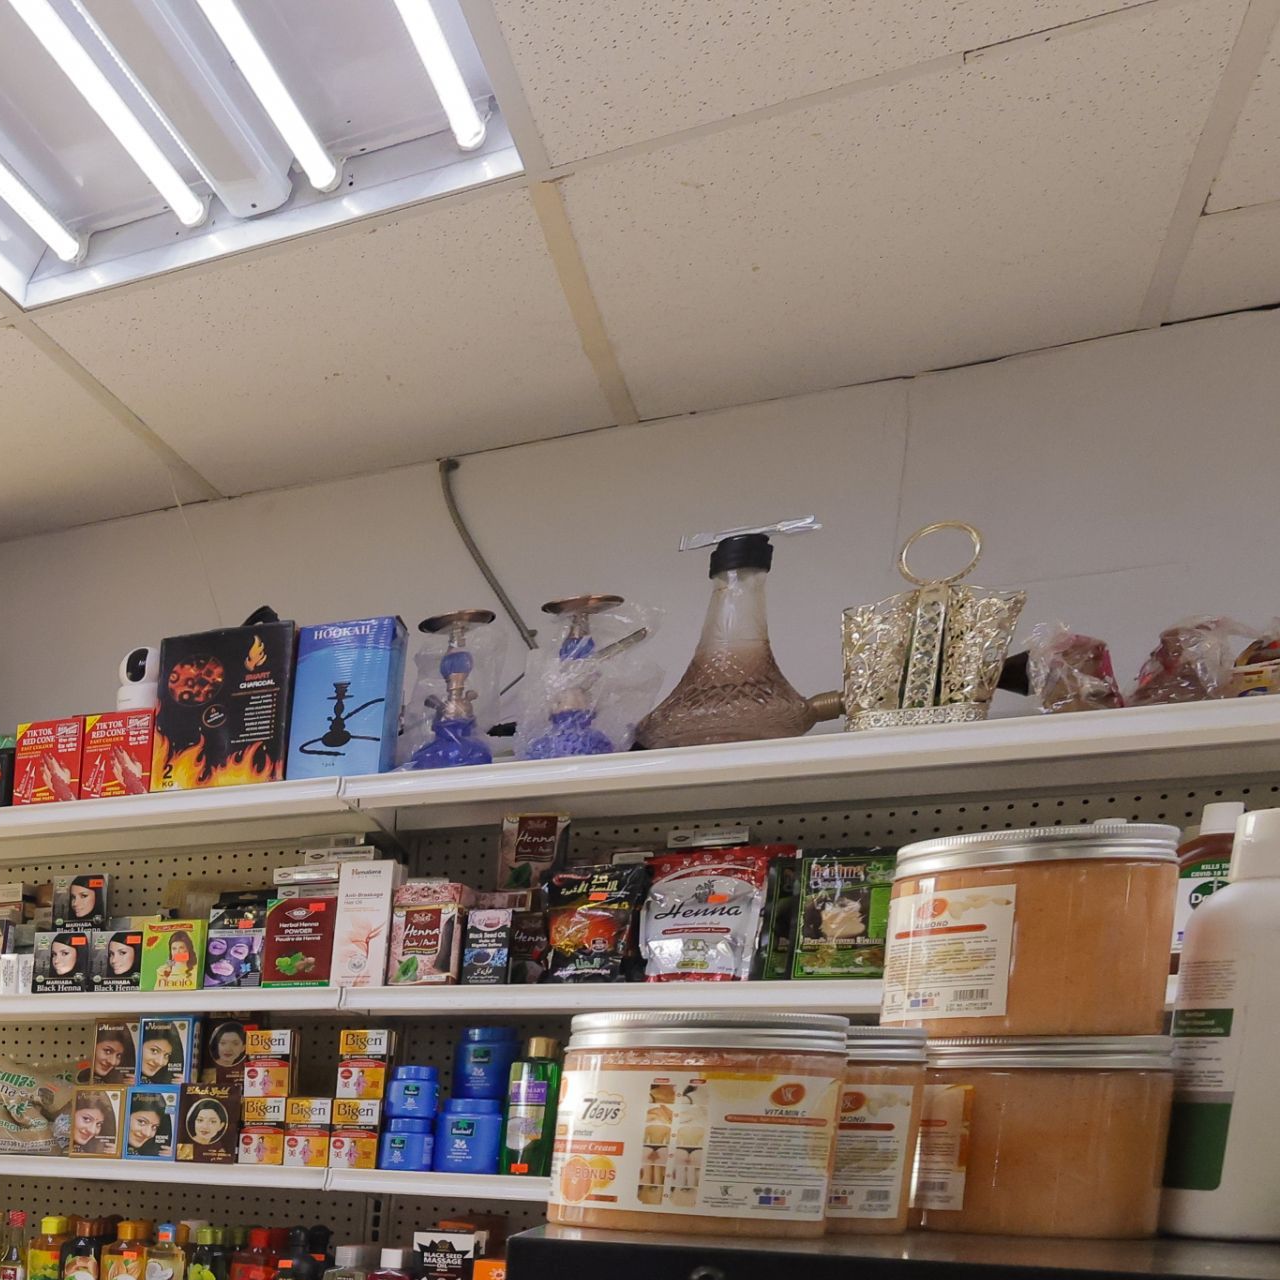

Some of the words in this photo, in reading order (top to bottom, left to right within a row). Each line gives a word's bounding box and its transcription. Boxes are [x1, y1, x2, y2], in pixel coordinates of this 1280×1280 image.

[314, 625, 371, 641] HOOKAH
[163, 765, 173, 779] 2
[516, 831, 555, 847] Henna
[654, 903, 742, 920] Henna
[405, 924, 439, 936] Henna
[58, 984, 81, 992] Henna
[115, 984, 139, 992] Henna
[250, 1032, 286, 1050] Bigen
[345, 1032, 383, 1050] Bigen
[245, 1100, 280, 1118] Bigen
[290, 1102, 326, 1120] Bigen
[338, 1102, 374, 1120] Bigen
[764, 1108, 798, 1116] VITAMIN
[800, 1108, 807, 1116] C
[576, 1168, 617, 1182] BONUS
[423, 1257, 463, 1266] MASSAGE
[446, 1252, 463, 1260] SEED
